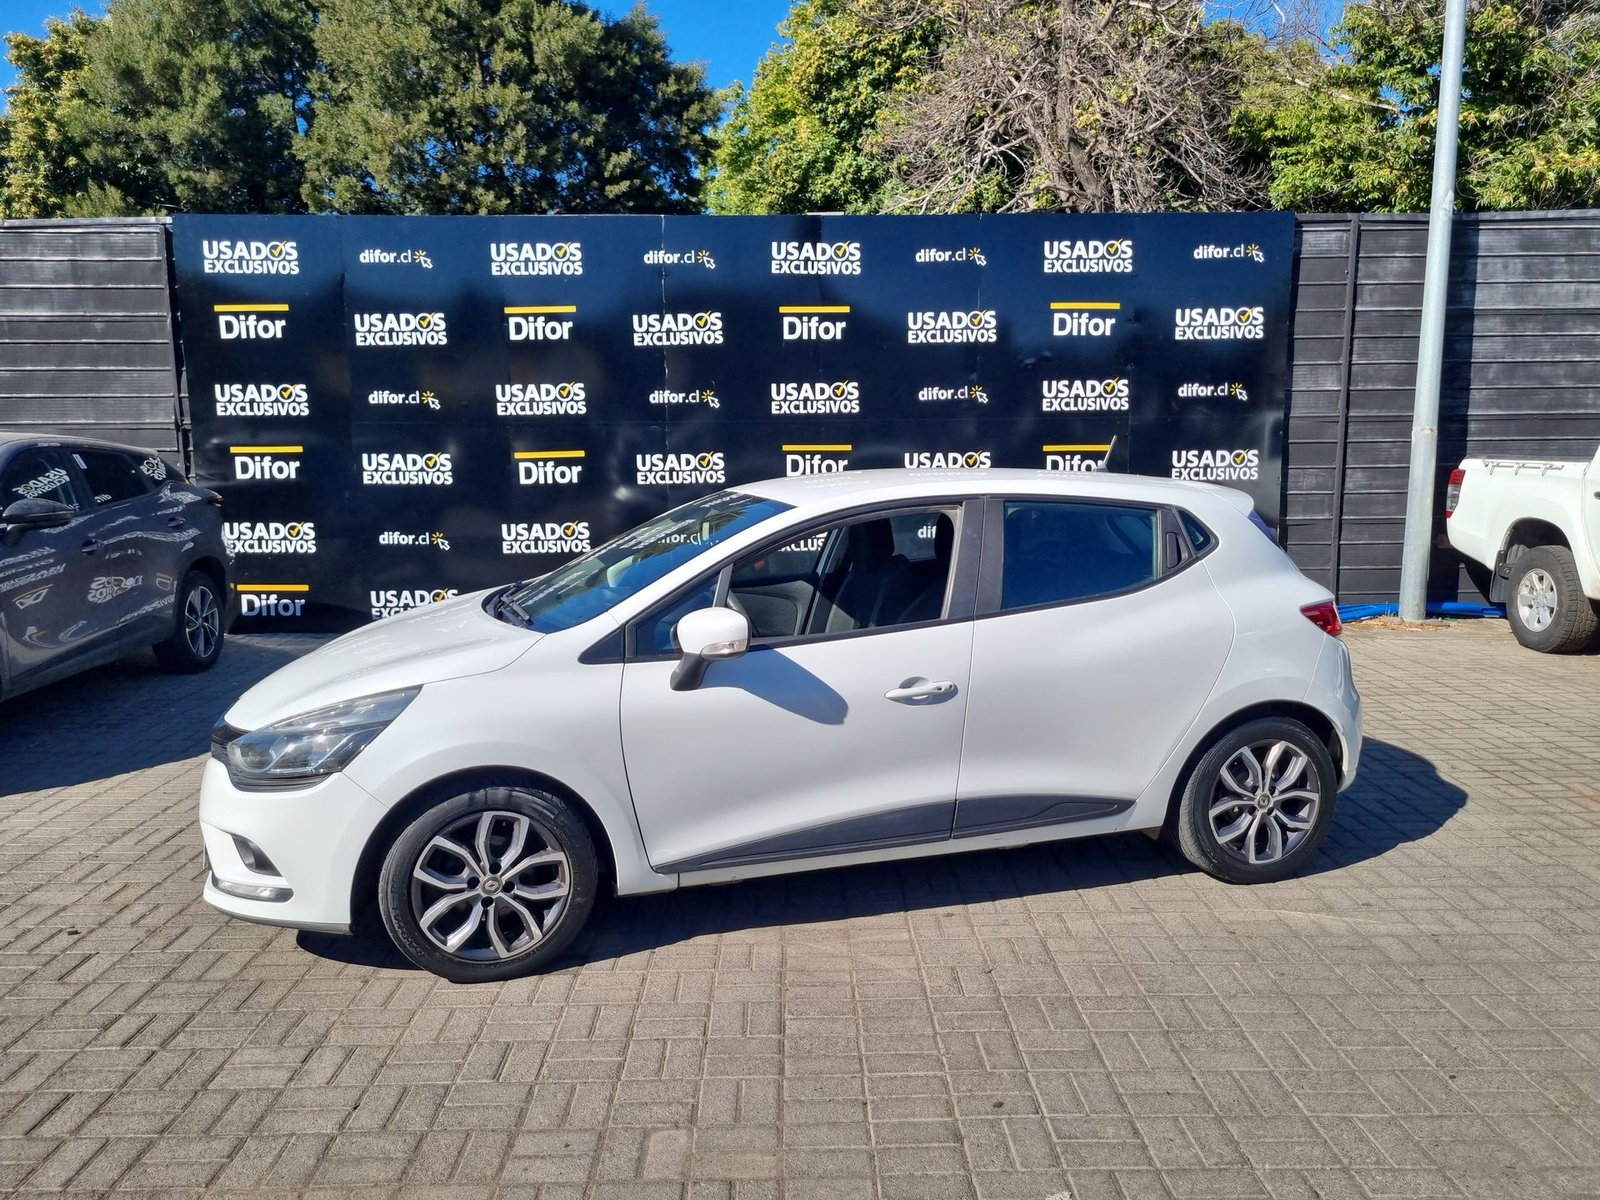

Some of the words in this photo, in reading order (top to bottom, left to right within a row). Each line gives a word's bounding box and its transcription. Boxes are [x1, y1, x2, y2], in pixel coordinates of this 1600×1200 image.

[202, 240, 298, 260] USADOS
[359, 248, 412, 264] difor.cl
[490, 242, 583, 262] USADOS
[643, 249, 695, 265] difor.cl
[771, 241, 861, 261] USADOS
[915, 247, 966, 263] difor.cl
[1043, 239, 1133, 259] USADOS
[1193, 243, 1244, 260] difor.cl
[203, 259, 300, 275] EXCLUSIVOS
[491, 261, 584, 276] EXCLUSIVOS
[771, 260, 862, 275] EXCLUSIVOS
[1043, 258, 1133, 273] EXCLUSIVOS
[354, 312, 446, 333] USADOS
[632, 312, 723, 332] USADOS
[907, 311, 997, 330] USADOS
[1053, 312, 1116, 336] Difor
[1175, 307, 1264, 326] USADOS
[218, 314, 287, 339] Difor
[508, 316, 573, 341] Difor
[782, 316, 847, 340] Difor
[1175, 325, 1264, 340] EXCLUSIVOS
[355, 331, 448, 346] EXCLUSIVOS
[633, 330, 724, 346] EXCLUSIVOS
[907, 329, 997, 343] EXCLUSIVOS
[214, 383, 308, 403] USADOS
[495, 382, 586, 402] USADOS
[649, 389, 700, 404] difor.cl
[771, 381, 859, 401] USADOS
[918, 385, 968, 401] difor.cl
[1042, 379, 1129, 398] USADOS
[1177, 381, 1228, 397] difor.cl
[368, 390, 420, 405] difor.cl
[1042, 397, 1129, 412] EXCLUSIVOS
[216, 401, 310, 416] EXCLUSIVOS
[496, 400, 587, 416] EXCLUSIVOS
[771, 399, 860, 415] EXCLUSIVOS
[361, 452, 452, 472] USADOS
[636, 452, 725, 471] USADOS
[786, 454, 849, 477] Difor
[904, 451, 992, 469] USADOS
[1046, 455, 1103, 471] Difo
[1172, 449, 1259, 467] USADOS
[234, 455, 300, 480] Difor
[518, 461, 582, 485] Difor
[1171, 467, 1259, 480] EXCLUSIVOS
[362, 470, 453, 485] EXCLUSIVOS
[636, 469, 726, 485] EXCLUSIVOS
[223, 521, 316, 540] USADOS
[378, 531, 430, 547] difor.cl
[501, 521, 590, 541] USADOS
[502, 539, 591, 554] EXCLUSIVOS
[240, 594, 306, 617] Difor
